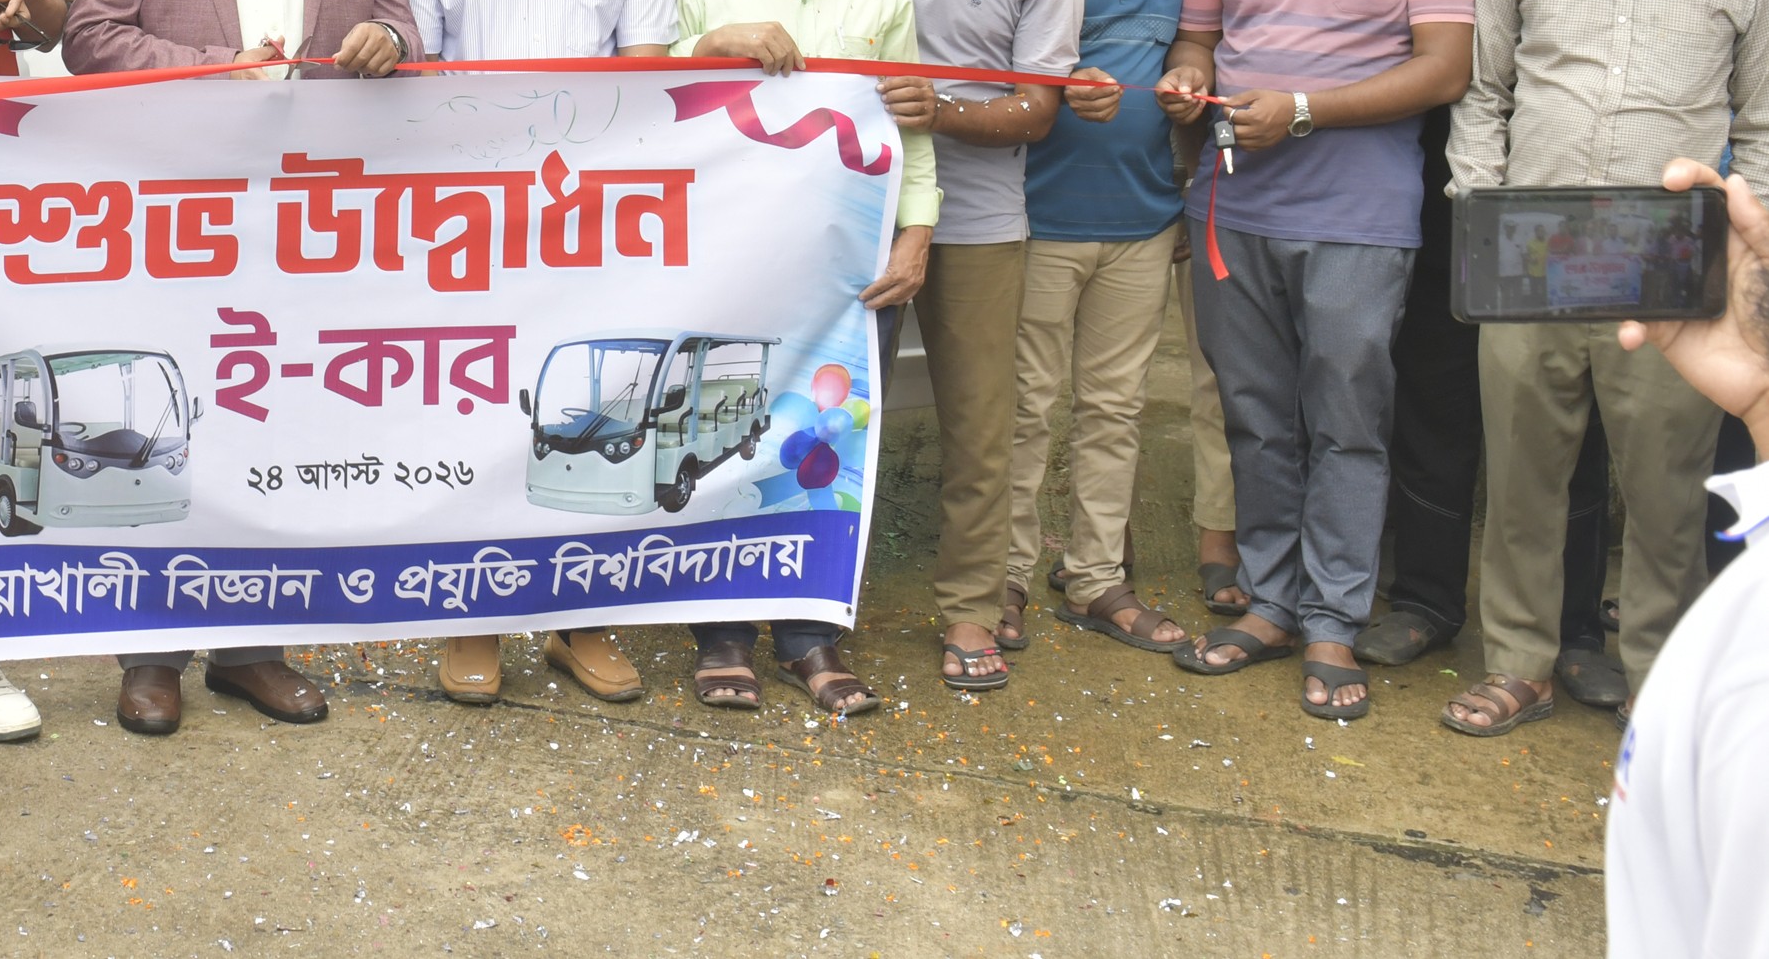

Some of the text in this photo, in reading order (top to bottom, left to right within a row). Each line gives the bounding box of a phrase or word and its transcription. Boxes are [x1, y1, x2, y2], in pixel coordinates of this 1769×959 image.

[270, 149, 696, 292] উদ্বোধন
[210, 307, 517, 423] ই-কার
[246, 453, 475, 496] ২৪ আগস্ট ২০২৬
[161, 553, 323, 611] বিজ্ঞান
[338, 567, 376, 605] ও
[394, 546, 539, 613] প্রযুক্তি
[548, 532, 815, 596] বিশ্ববিদ্যালয়
